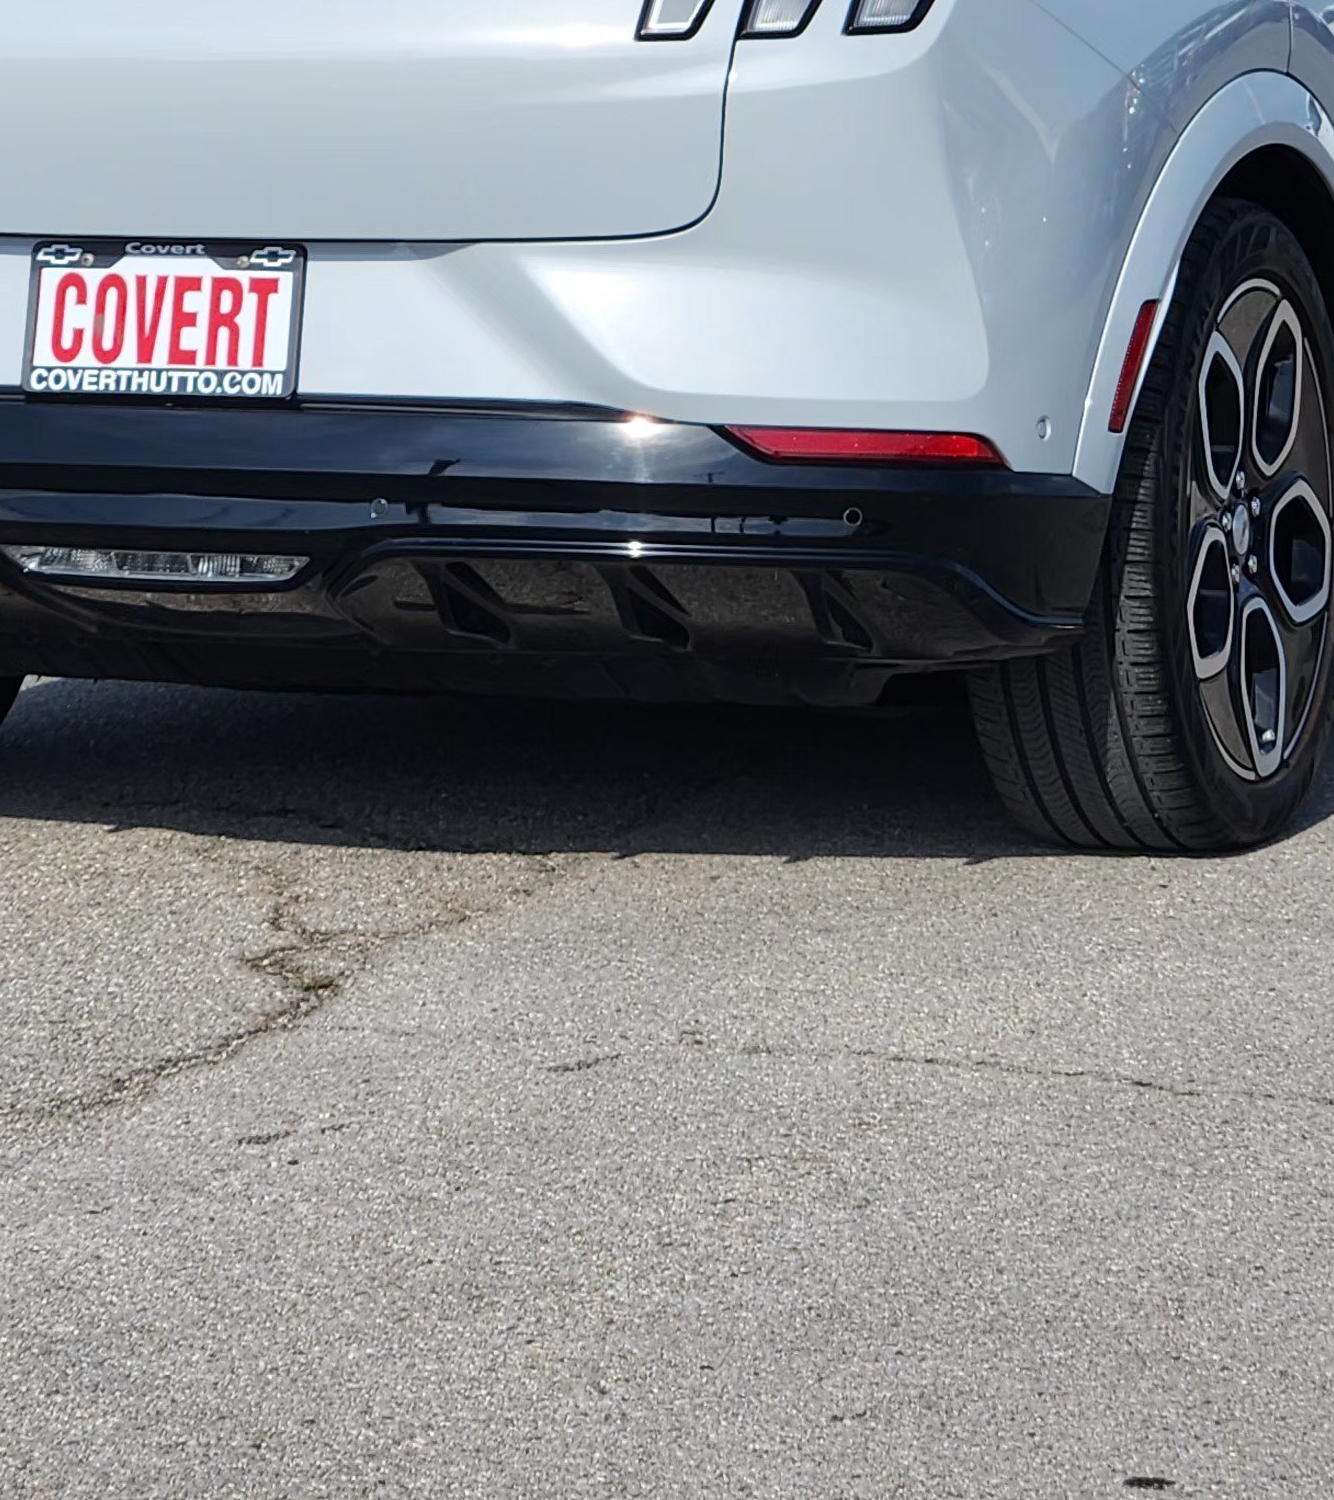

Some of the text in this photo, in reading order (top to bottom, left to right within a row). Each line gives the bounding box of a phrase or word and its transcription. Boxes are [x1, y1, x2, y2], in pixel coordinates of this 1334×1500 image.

[124, 241, 206, 256] Covert
[51, 271, 280, 368] COVERT
[29, 368, 284, 396] COVERTHUTTO.COM
